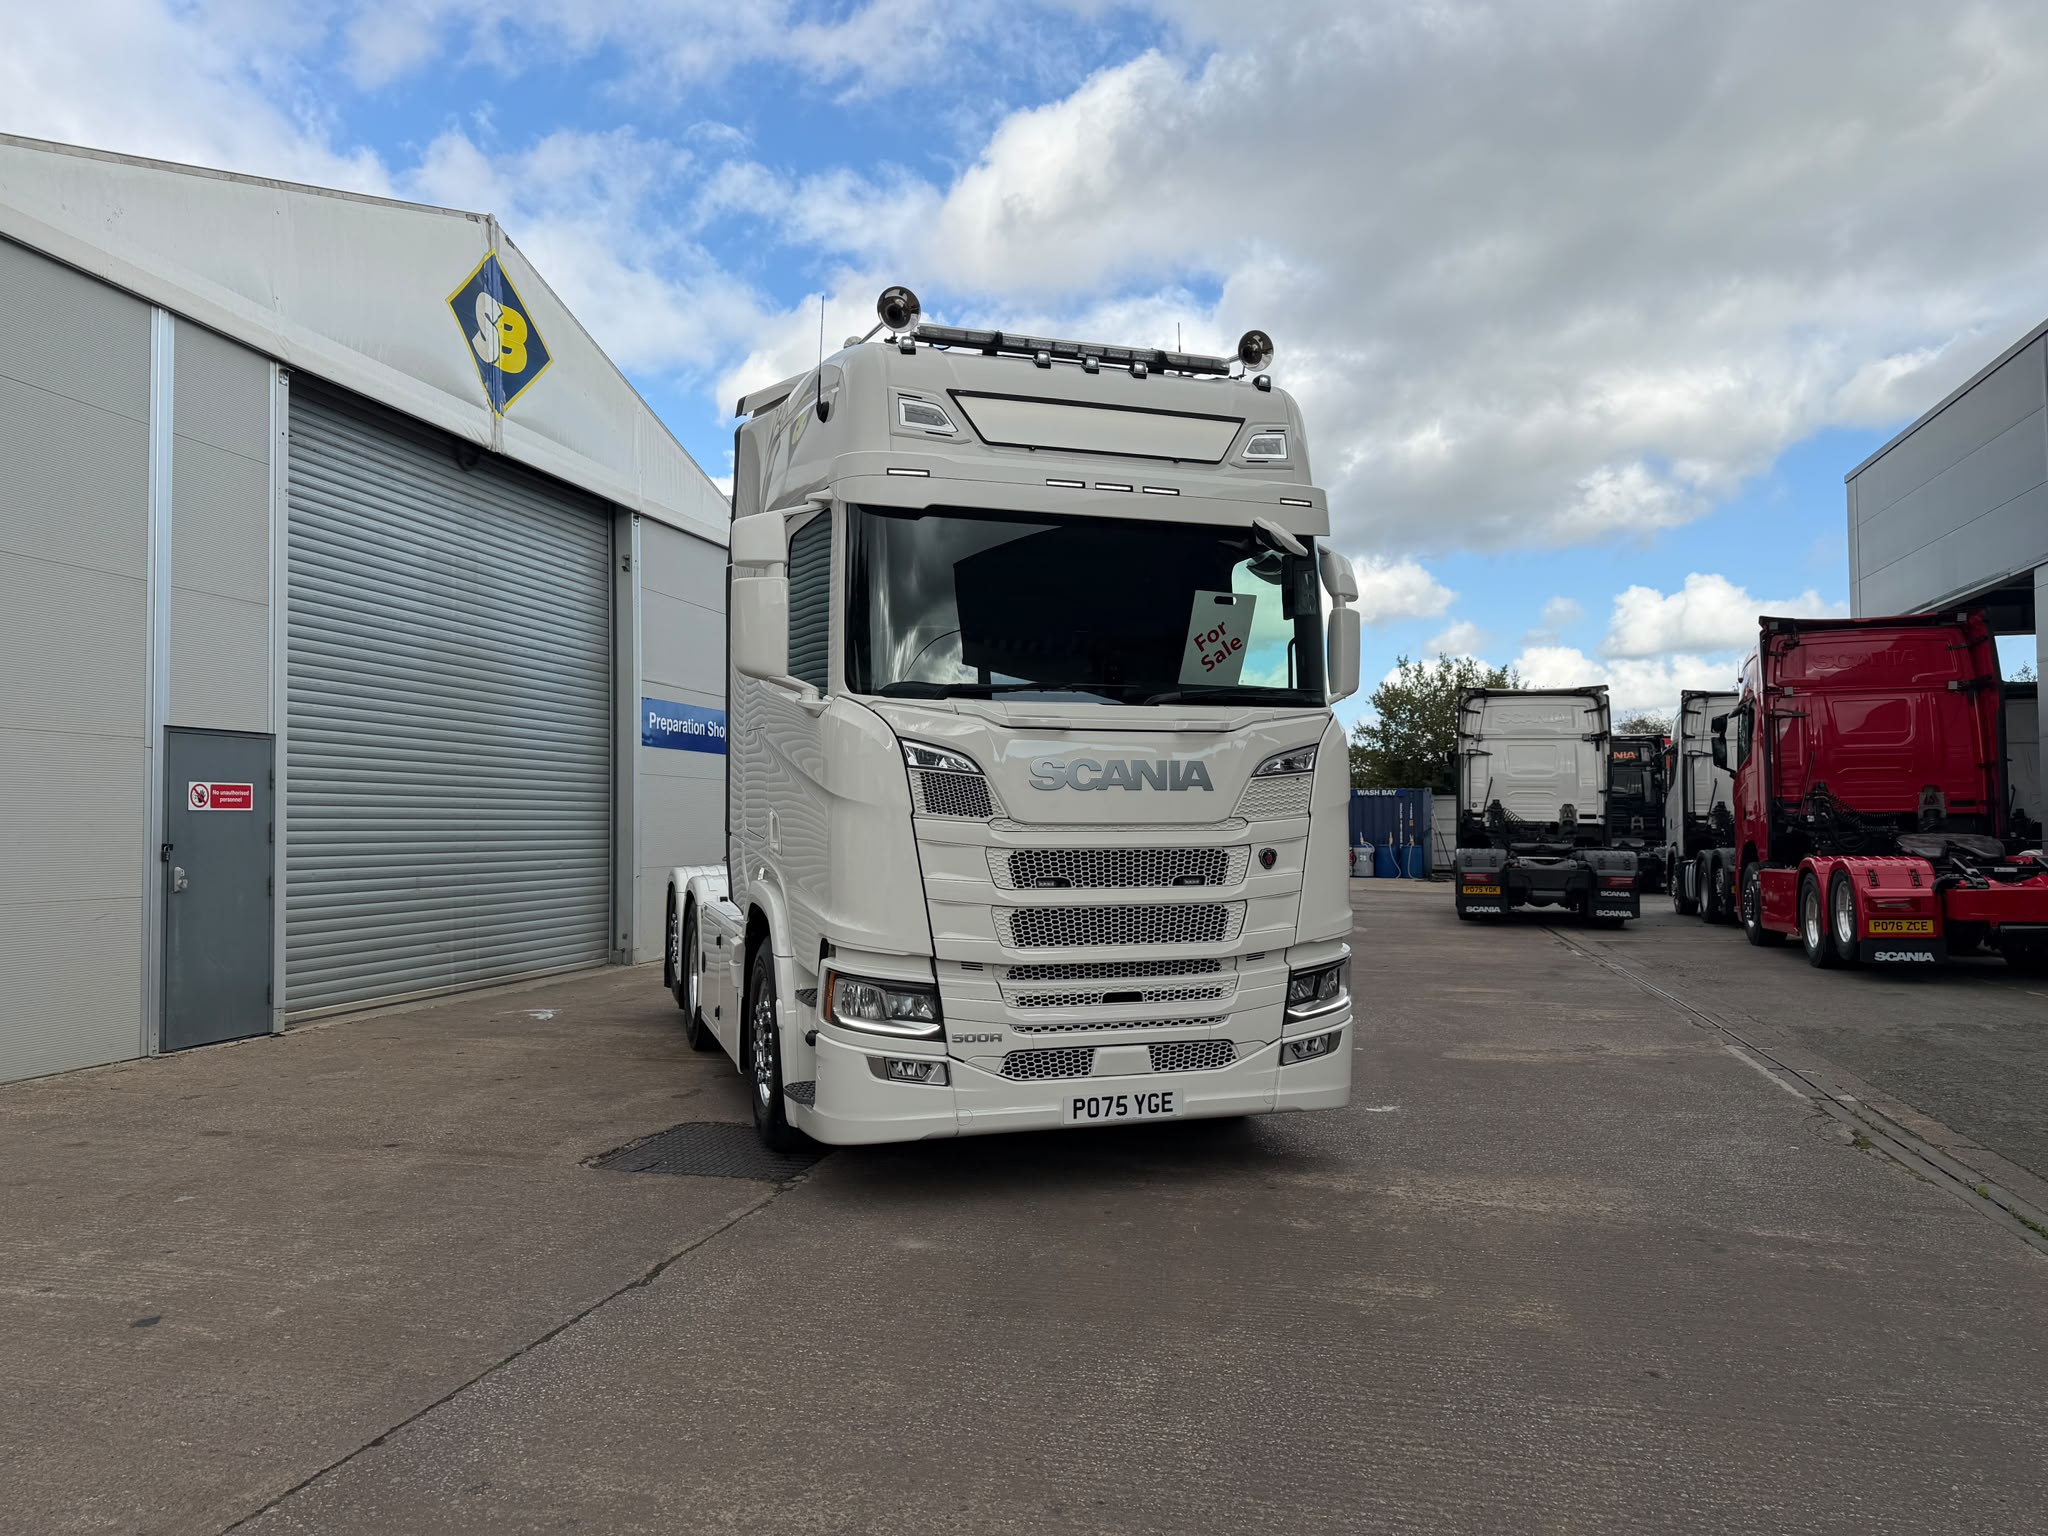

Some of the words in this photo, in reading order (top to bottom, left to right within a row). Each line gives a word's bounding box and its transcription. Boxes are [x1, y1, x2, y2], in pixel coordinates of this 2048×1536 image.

[471, 291, 528, 374] SB
[1193, 621, 1227, 653] For
[1201, 637, 1243, 673] Sale
[649, 711, 705, 736] Preparation
[707, 720, 726, 743] Sho
[1029, 757, 1214, 791] SCANIA
[1600, 890, 1631, 898] SCANIA
[1466, 905, 1501, 913] SCANIA
[1596, 909, 1633, 917] SCANIA
[1873, 921, 1903, 931] PO76
[1906, 921, 1929, 931] ZCE
[1874, 951, 1935, 962] SCANIA
[952, 1032, 1003, 1043] 500R
[1073, 1095, 1128, 1119] PO75
[1134, 1091, 1174, 1115] YGE
